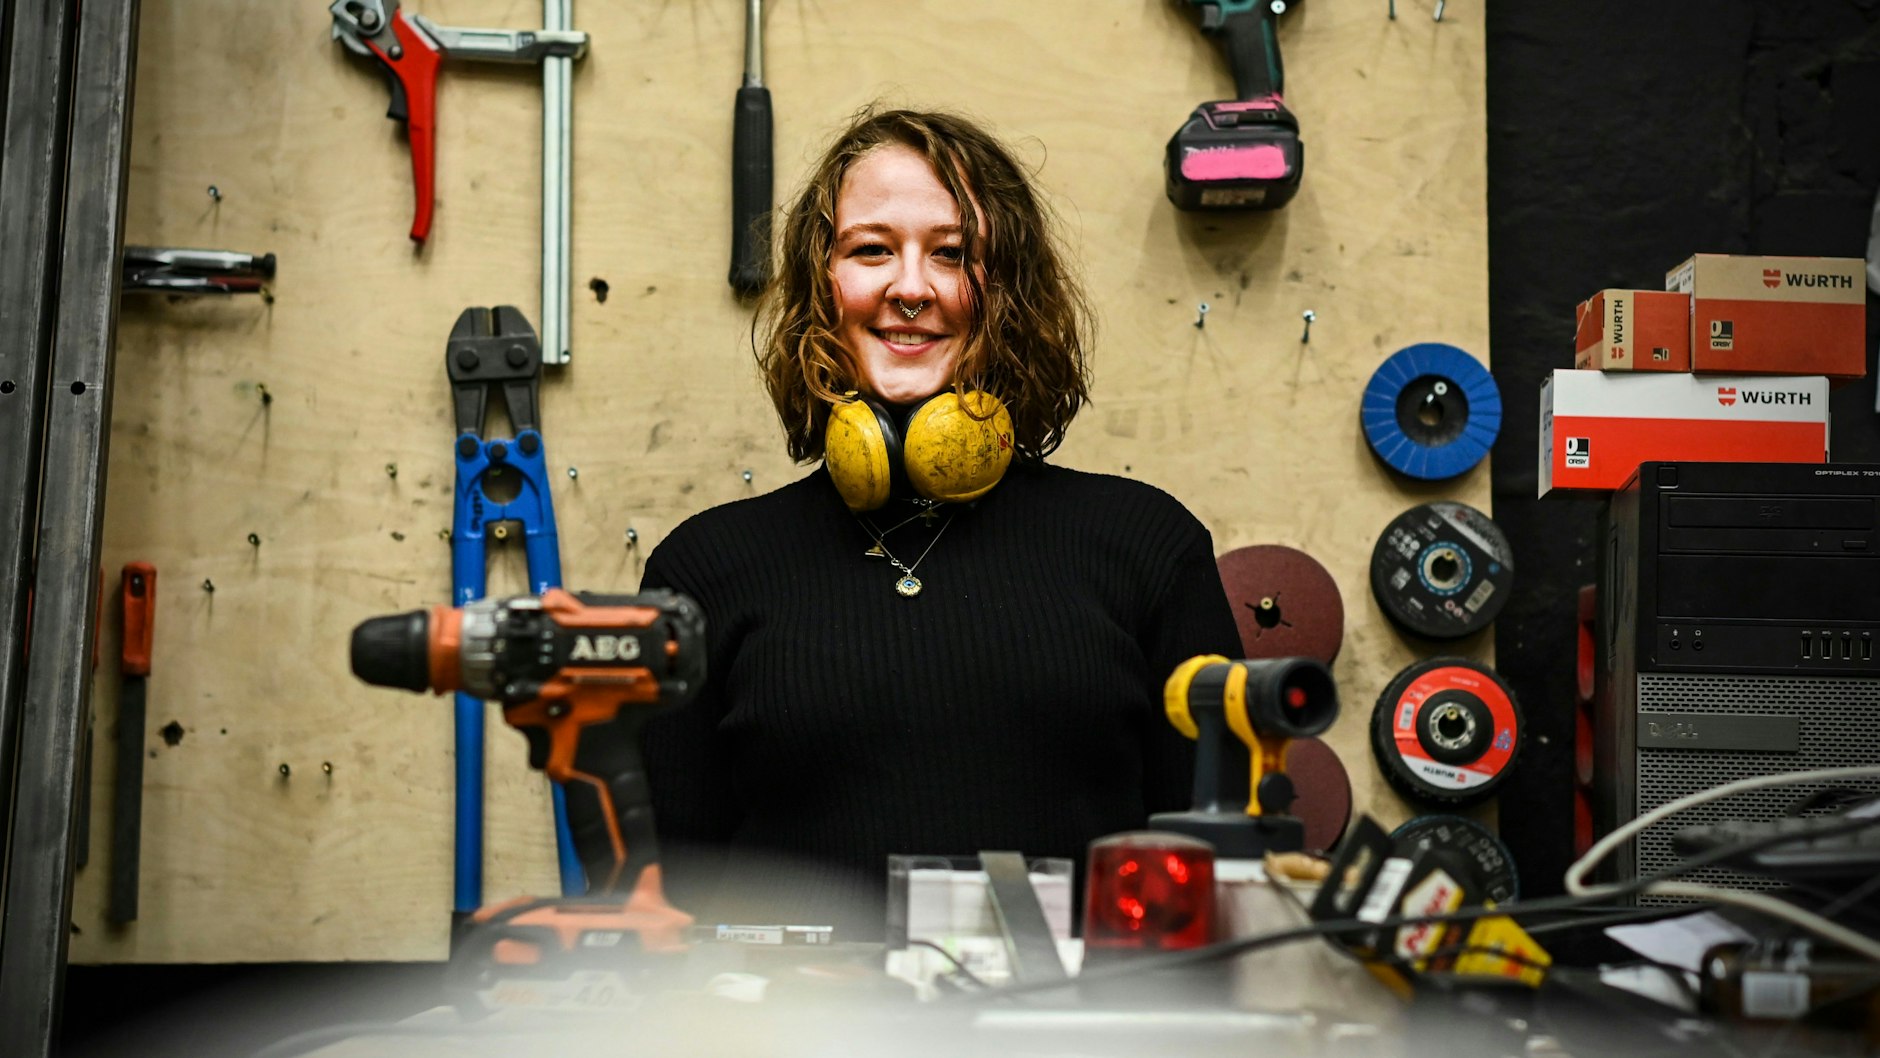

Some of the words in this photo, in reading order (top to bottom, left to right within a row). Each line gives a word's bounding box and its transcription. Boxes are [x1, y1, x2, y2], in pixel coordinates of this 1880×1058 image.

[1786, 273, 1852, 288] WÜRTH
[1613, 299, 1623, 344] WÜRTH
[1742, 391, 1811, 405] WÜRTH
[570, 634, 641, 661] AEG
